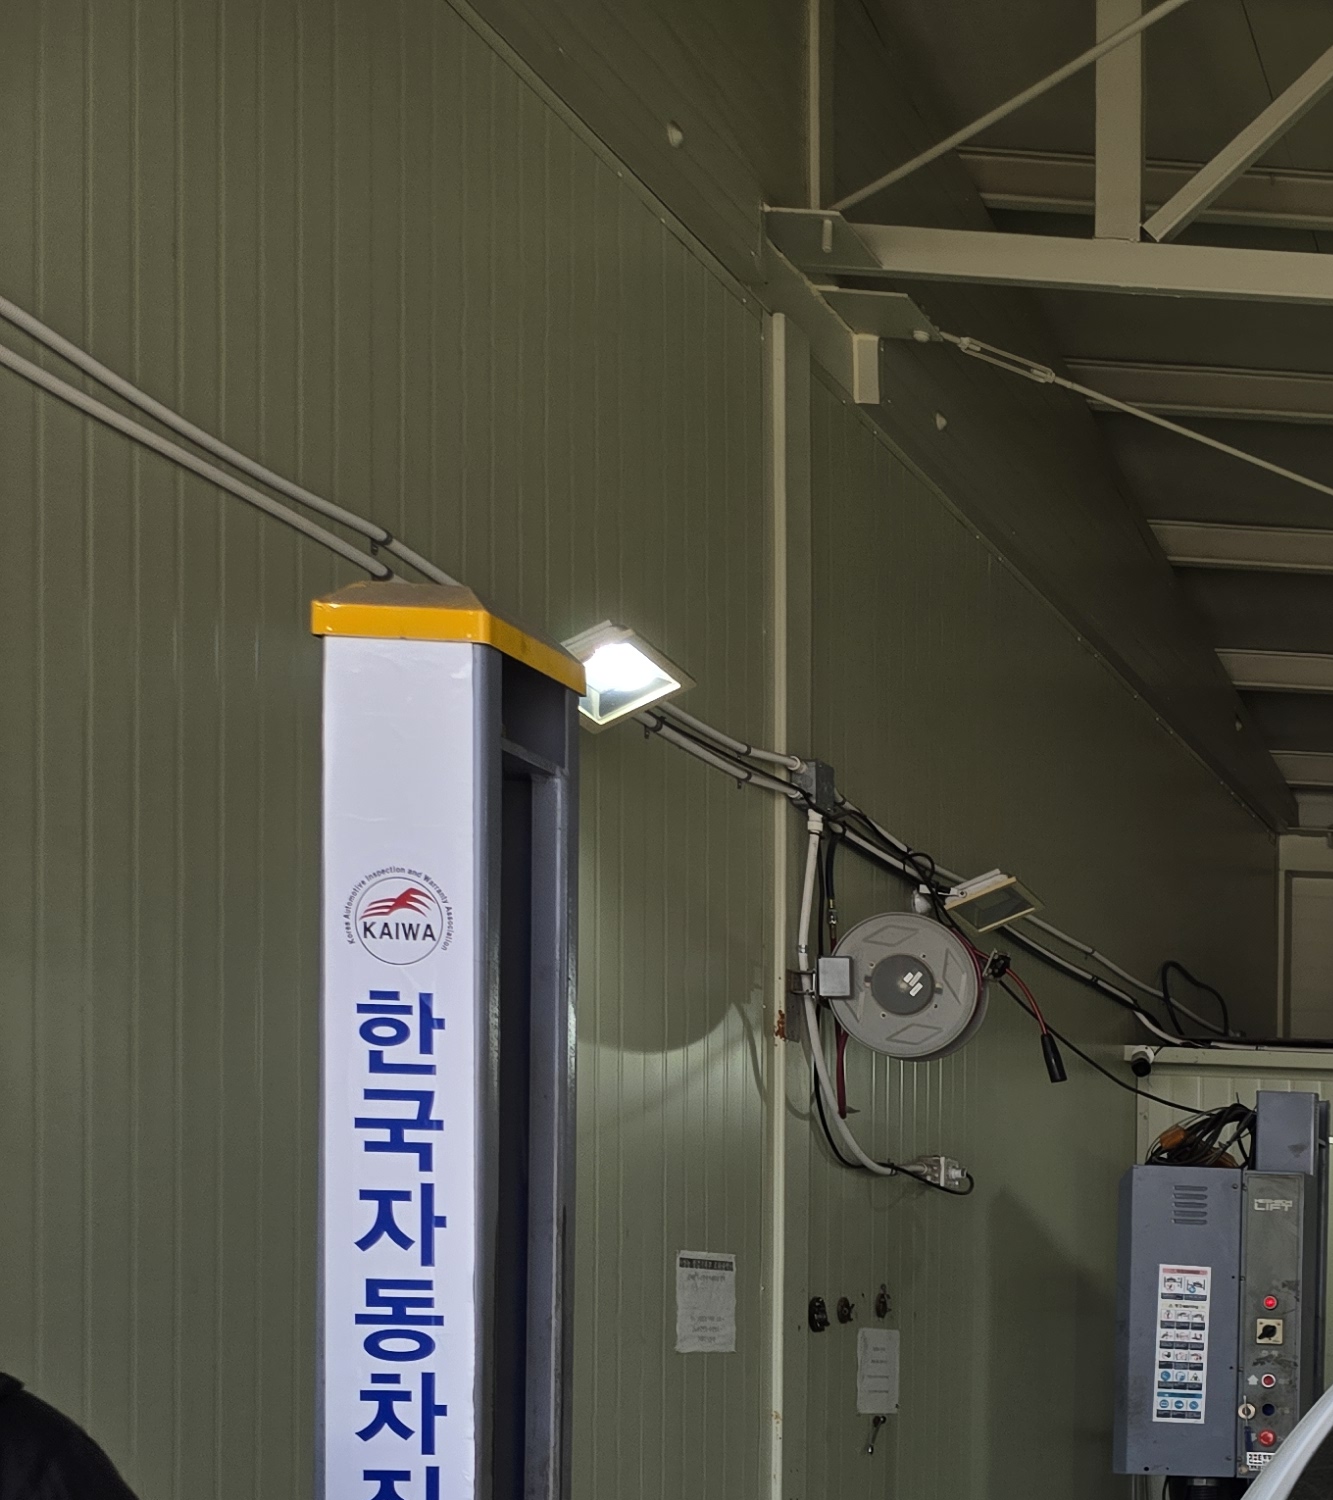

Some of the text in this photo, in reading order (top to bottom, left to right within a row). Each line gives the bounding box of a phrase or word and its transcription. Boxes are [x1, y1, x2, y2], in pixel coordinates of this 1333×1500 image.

[343, 866, 454, 951] Korea Automotive Inspection and Warranty Association
[363, 921, 436, 941] KAIWA
